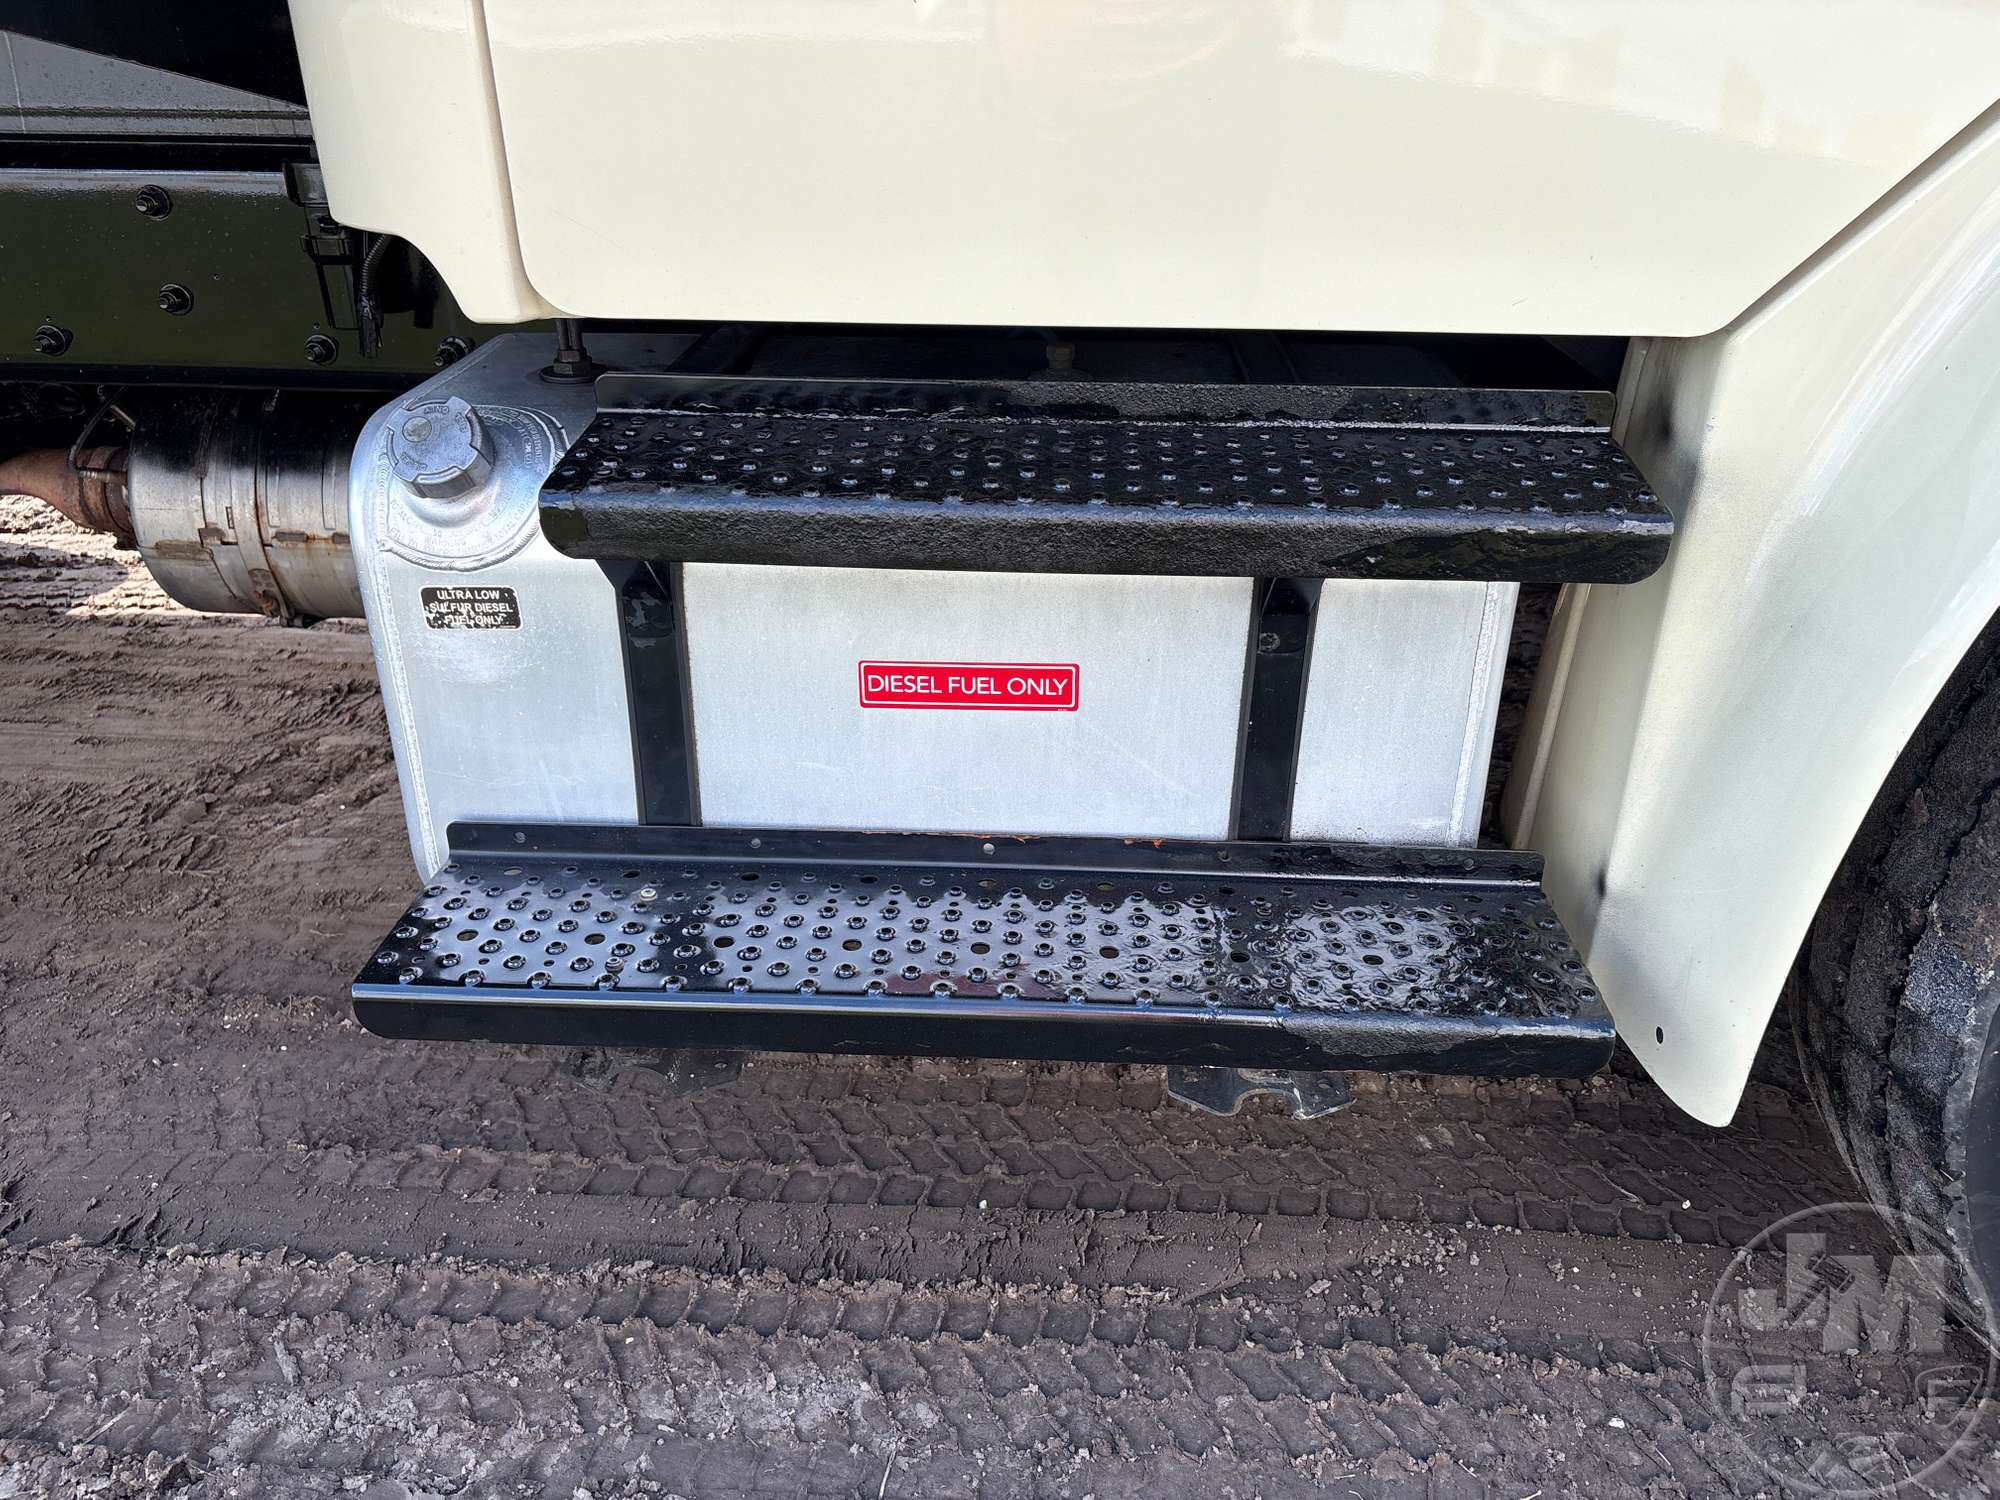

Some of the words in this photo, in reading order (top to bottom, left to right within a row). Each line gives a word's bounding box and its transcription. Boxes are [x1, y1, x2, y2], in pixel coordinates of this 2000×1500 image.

[437, 590, 473, 600] ULTRA
[474, 590, 500, 600] LOW
[429, 602, 472, 613] SULFUR
[475, 603, 513, 613] DIESEL
[444, 614, 471, 625] FUEL
[475, 615, 503, 625] ONLY
[867, 674, 942, 694] DIESEL
[948, 676, 1001, 695] FUEL
[1007, 677, 1068, 696] ONLY
